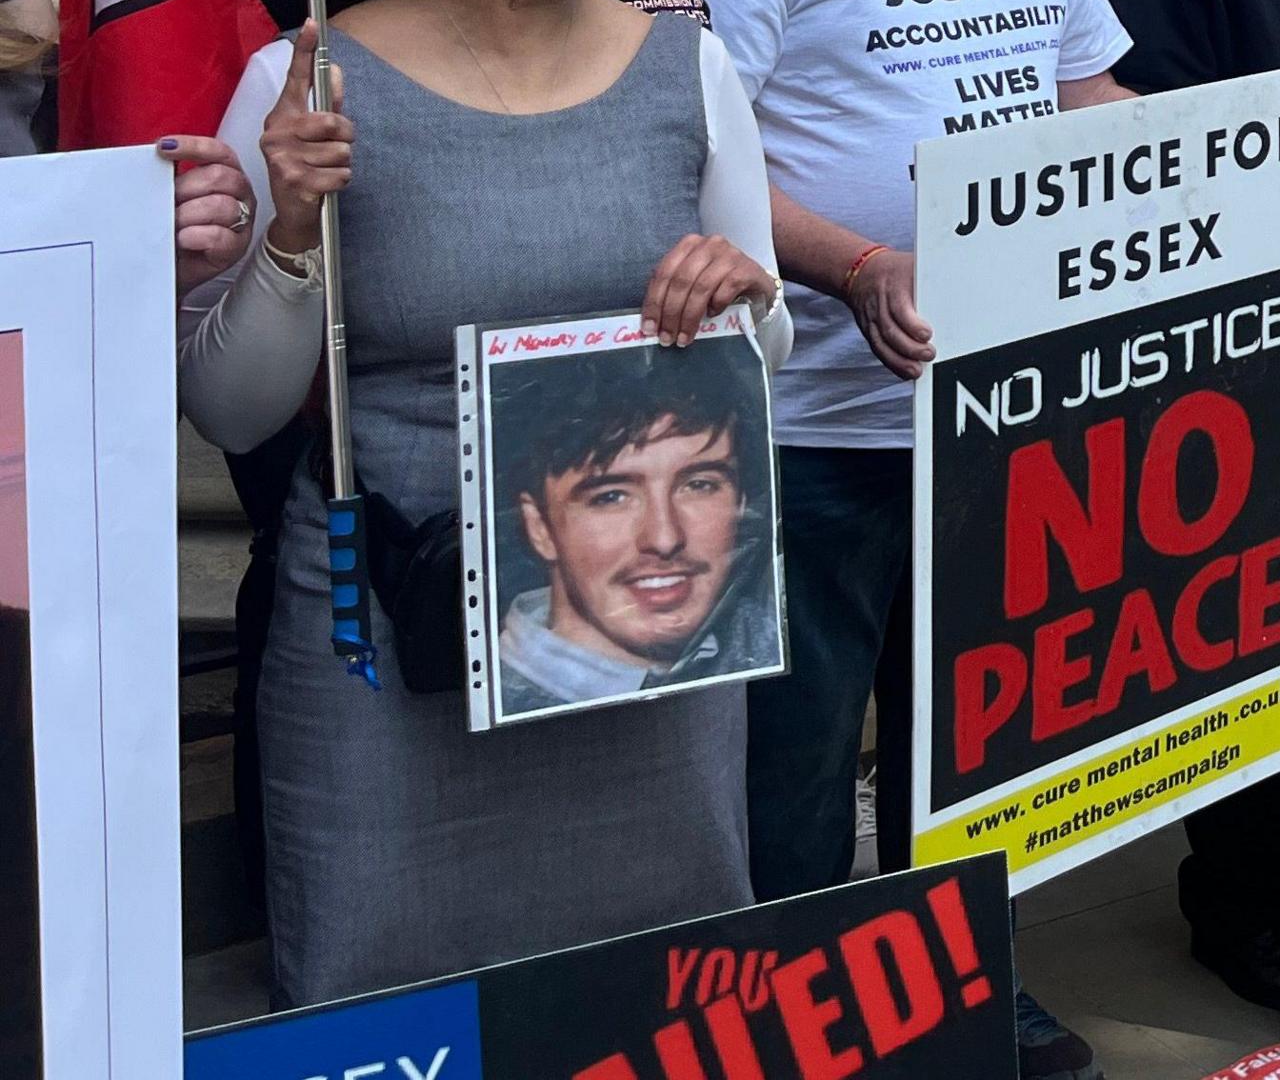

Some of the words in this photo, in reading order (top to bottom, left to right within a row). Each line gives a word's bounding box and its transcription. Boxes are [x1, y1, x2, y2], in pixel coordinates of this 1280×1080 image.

[866, 5, 1065, 52] ACCOUNTABILITY
[929, 56, 962, 68] CURE
[964, 48, 1009, 63] MENTAL
[955, 66, 1039, 103] LIVES
[955, 138, 1181, 236] JUSTICE
[1058, 213, 1222, 300] ESSEX
[956, 366, 1043, 437] NO
[1004, 389, 1254, 619] NO
[1024, 743, 1240, 854] #matthewscampaign
[1032, 776, 1080, 811] cure
[1087, 737, 1159, 790] mental
[1165, 710, 1229, 753] health
[665, 945, 780, 1013] YOU
